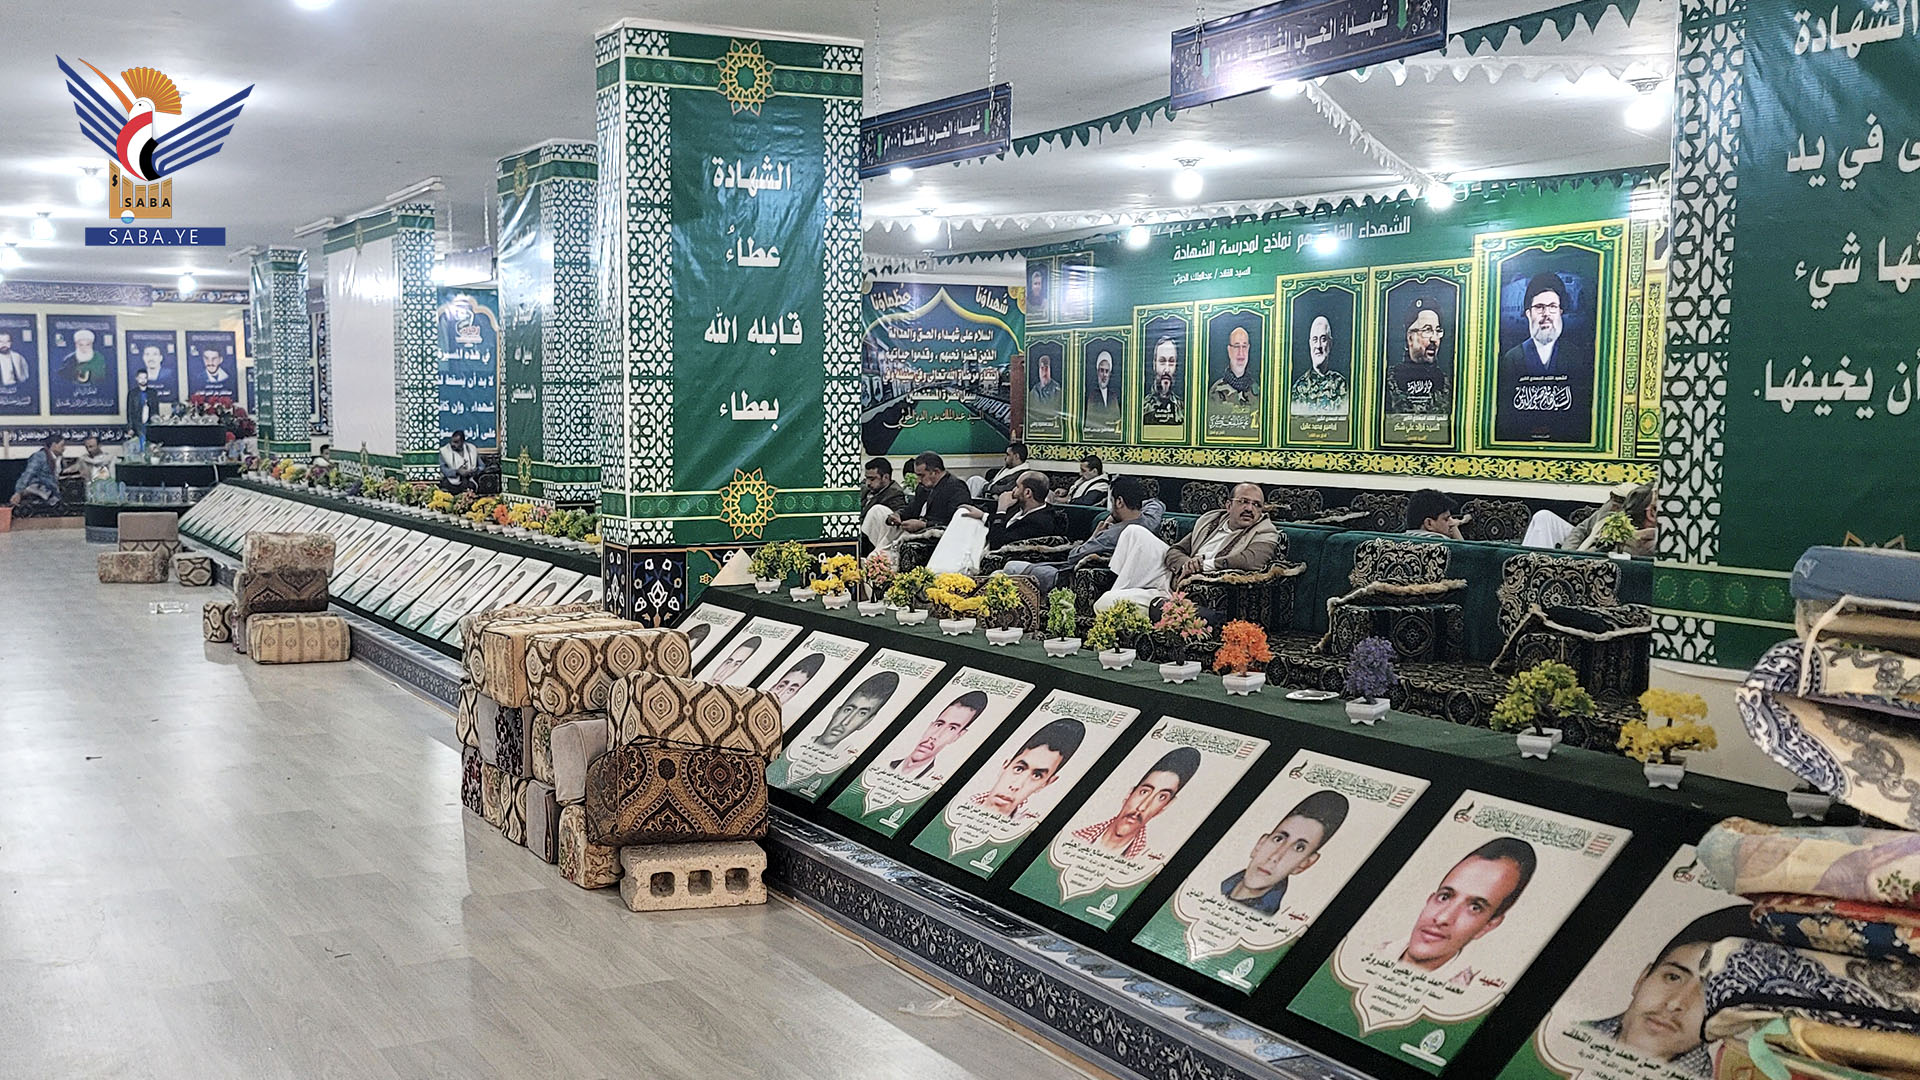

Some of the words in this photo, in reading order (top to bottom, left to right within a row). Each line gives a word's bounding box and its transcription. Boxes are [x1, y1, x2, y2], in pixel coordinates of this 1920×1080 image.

[1340, 0, 1389, 36] شهداء
[1294, 17, 1336, 54] الحرب
[902, 122, 928, 146] الثالثة
[928, 120, 953, 146] الحرب
[954, 110, 981, 137] شهداء
[1787, 132, 1826, 188] يد
[1838, 113, 1884, 190] في
[712, 155, 792, 197] الشهادة
[1358, 214, 1411, 239] الشهداء
[1173, 239, 1215, 261] الشهادة
[1218, 235, 1259, 255] لمدرسة
[1263, 230, 1292, 254] نماذج
[1795, 231, 1862, 310] شيء
[704, 307, 738, 344] الله
[747, 311, 803, 356] قابله
[437, 347, 463, 362] المسيرة
[464, 348, 481, 360] هذه
[482, 348, 491, 365] في
[467, 372, 476, 388] أن
[478, 377, 487, 388] بد
[488, 375, 494, 387] لا
[471, 400, 495, 413] شهداء
[719, 390, 779, 432] بعطاء
